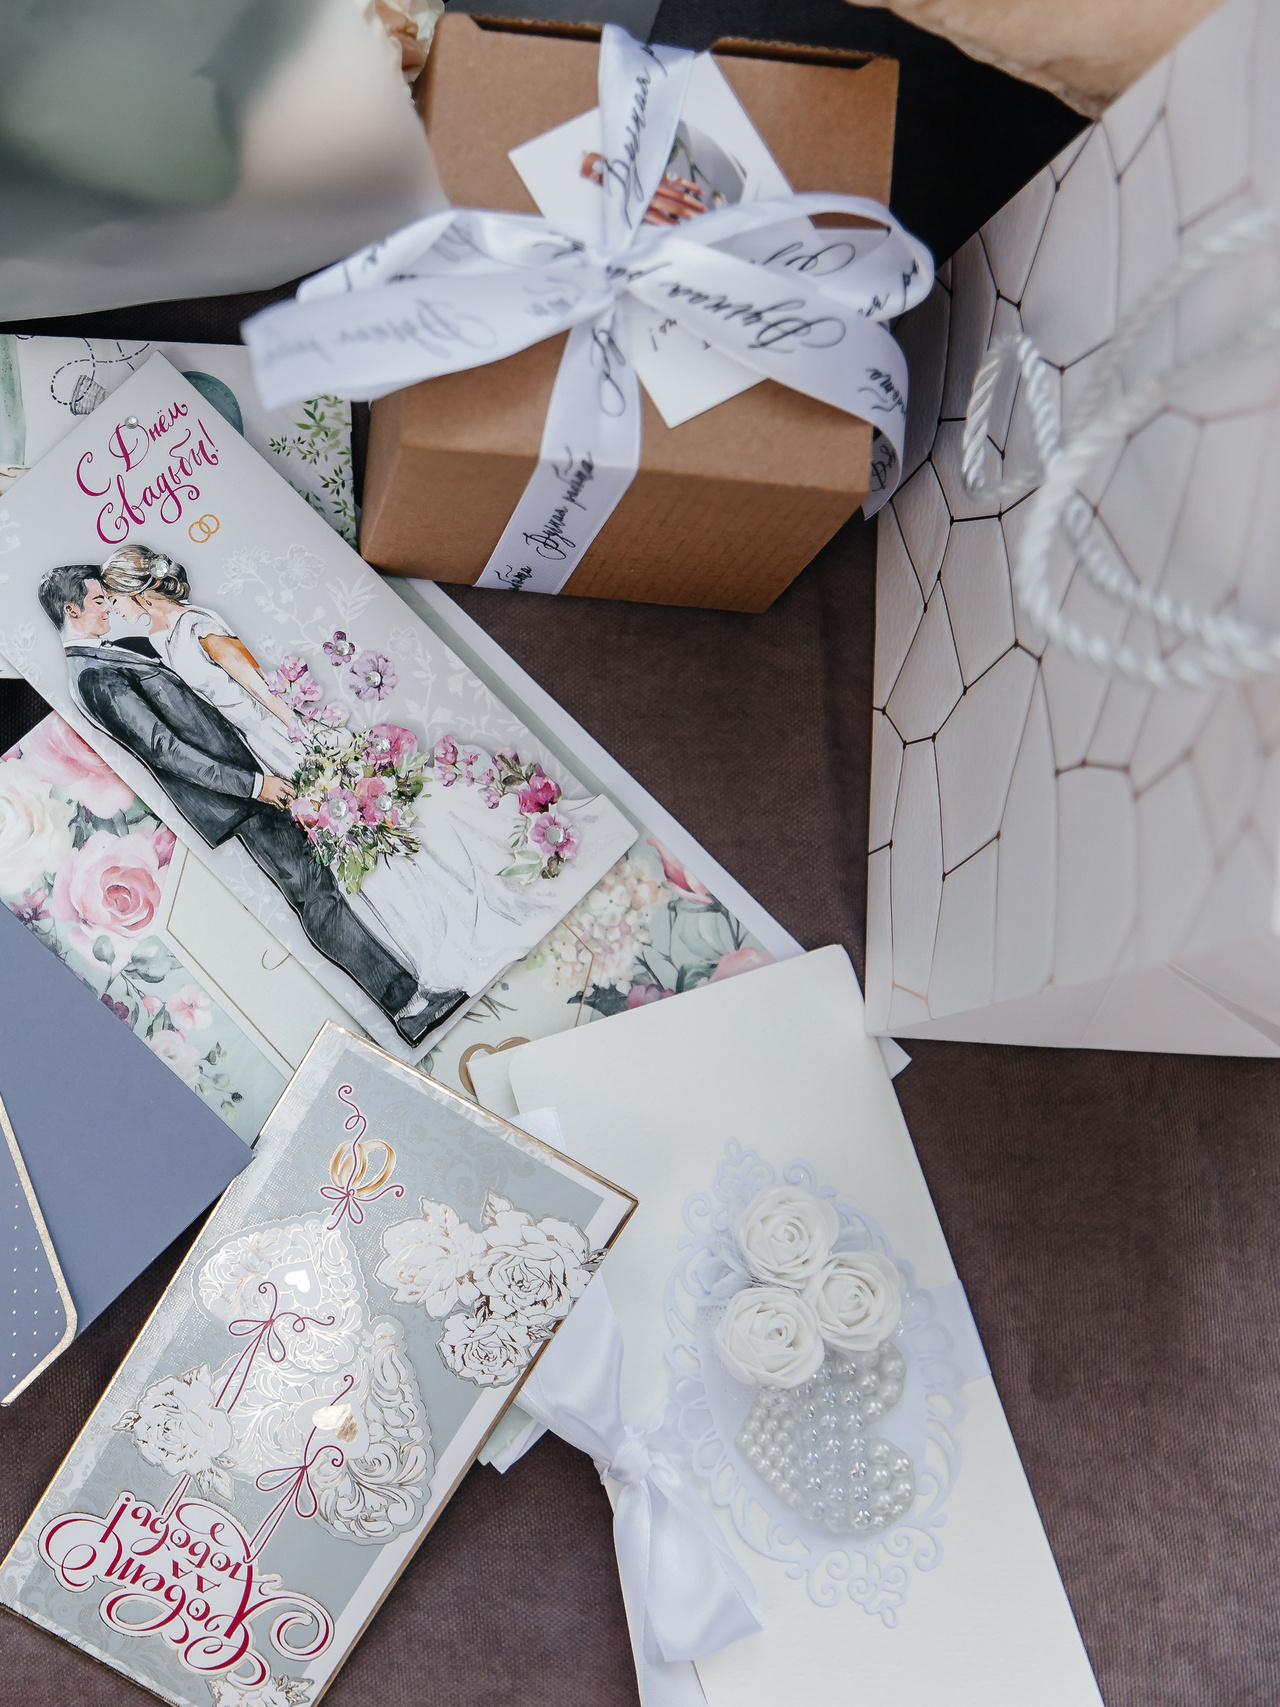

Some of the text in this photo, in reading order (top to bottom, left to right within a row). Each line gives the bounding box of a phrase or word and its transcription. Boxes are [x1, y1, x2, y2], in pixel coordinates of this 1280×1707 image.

[76, 401, 189, 497] С Днём
[45, 1518, 268, 1686] Совет
